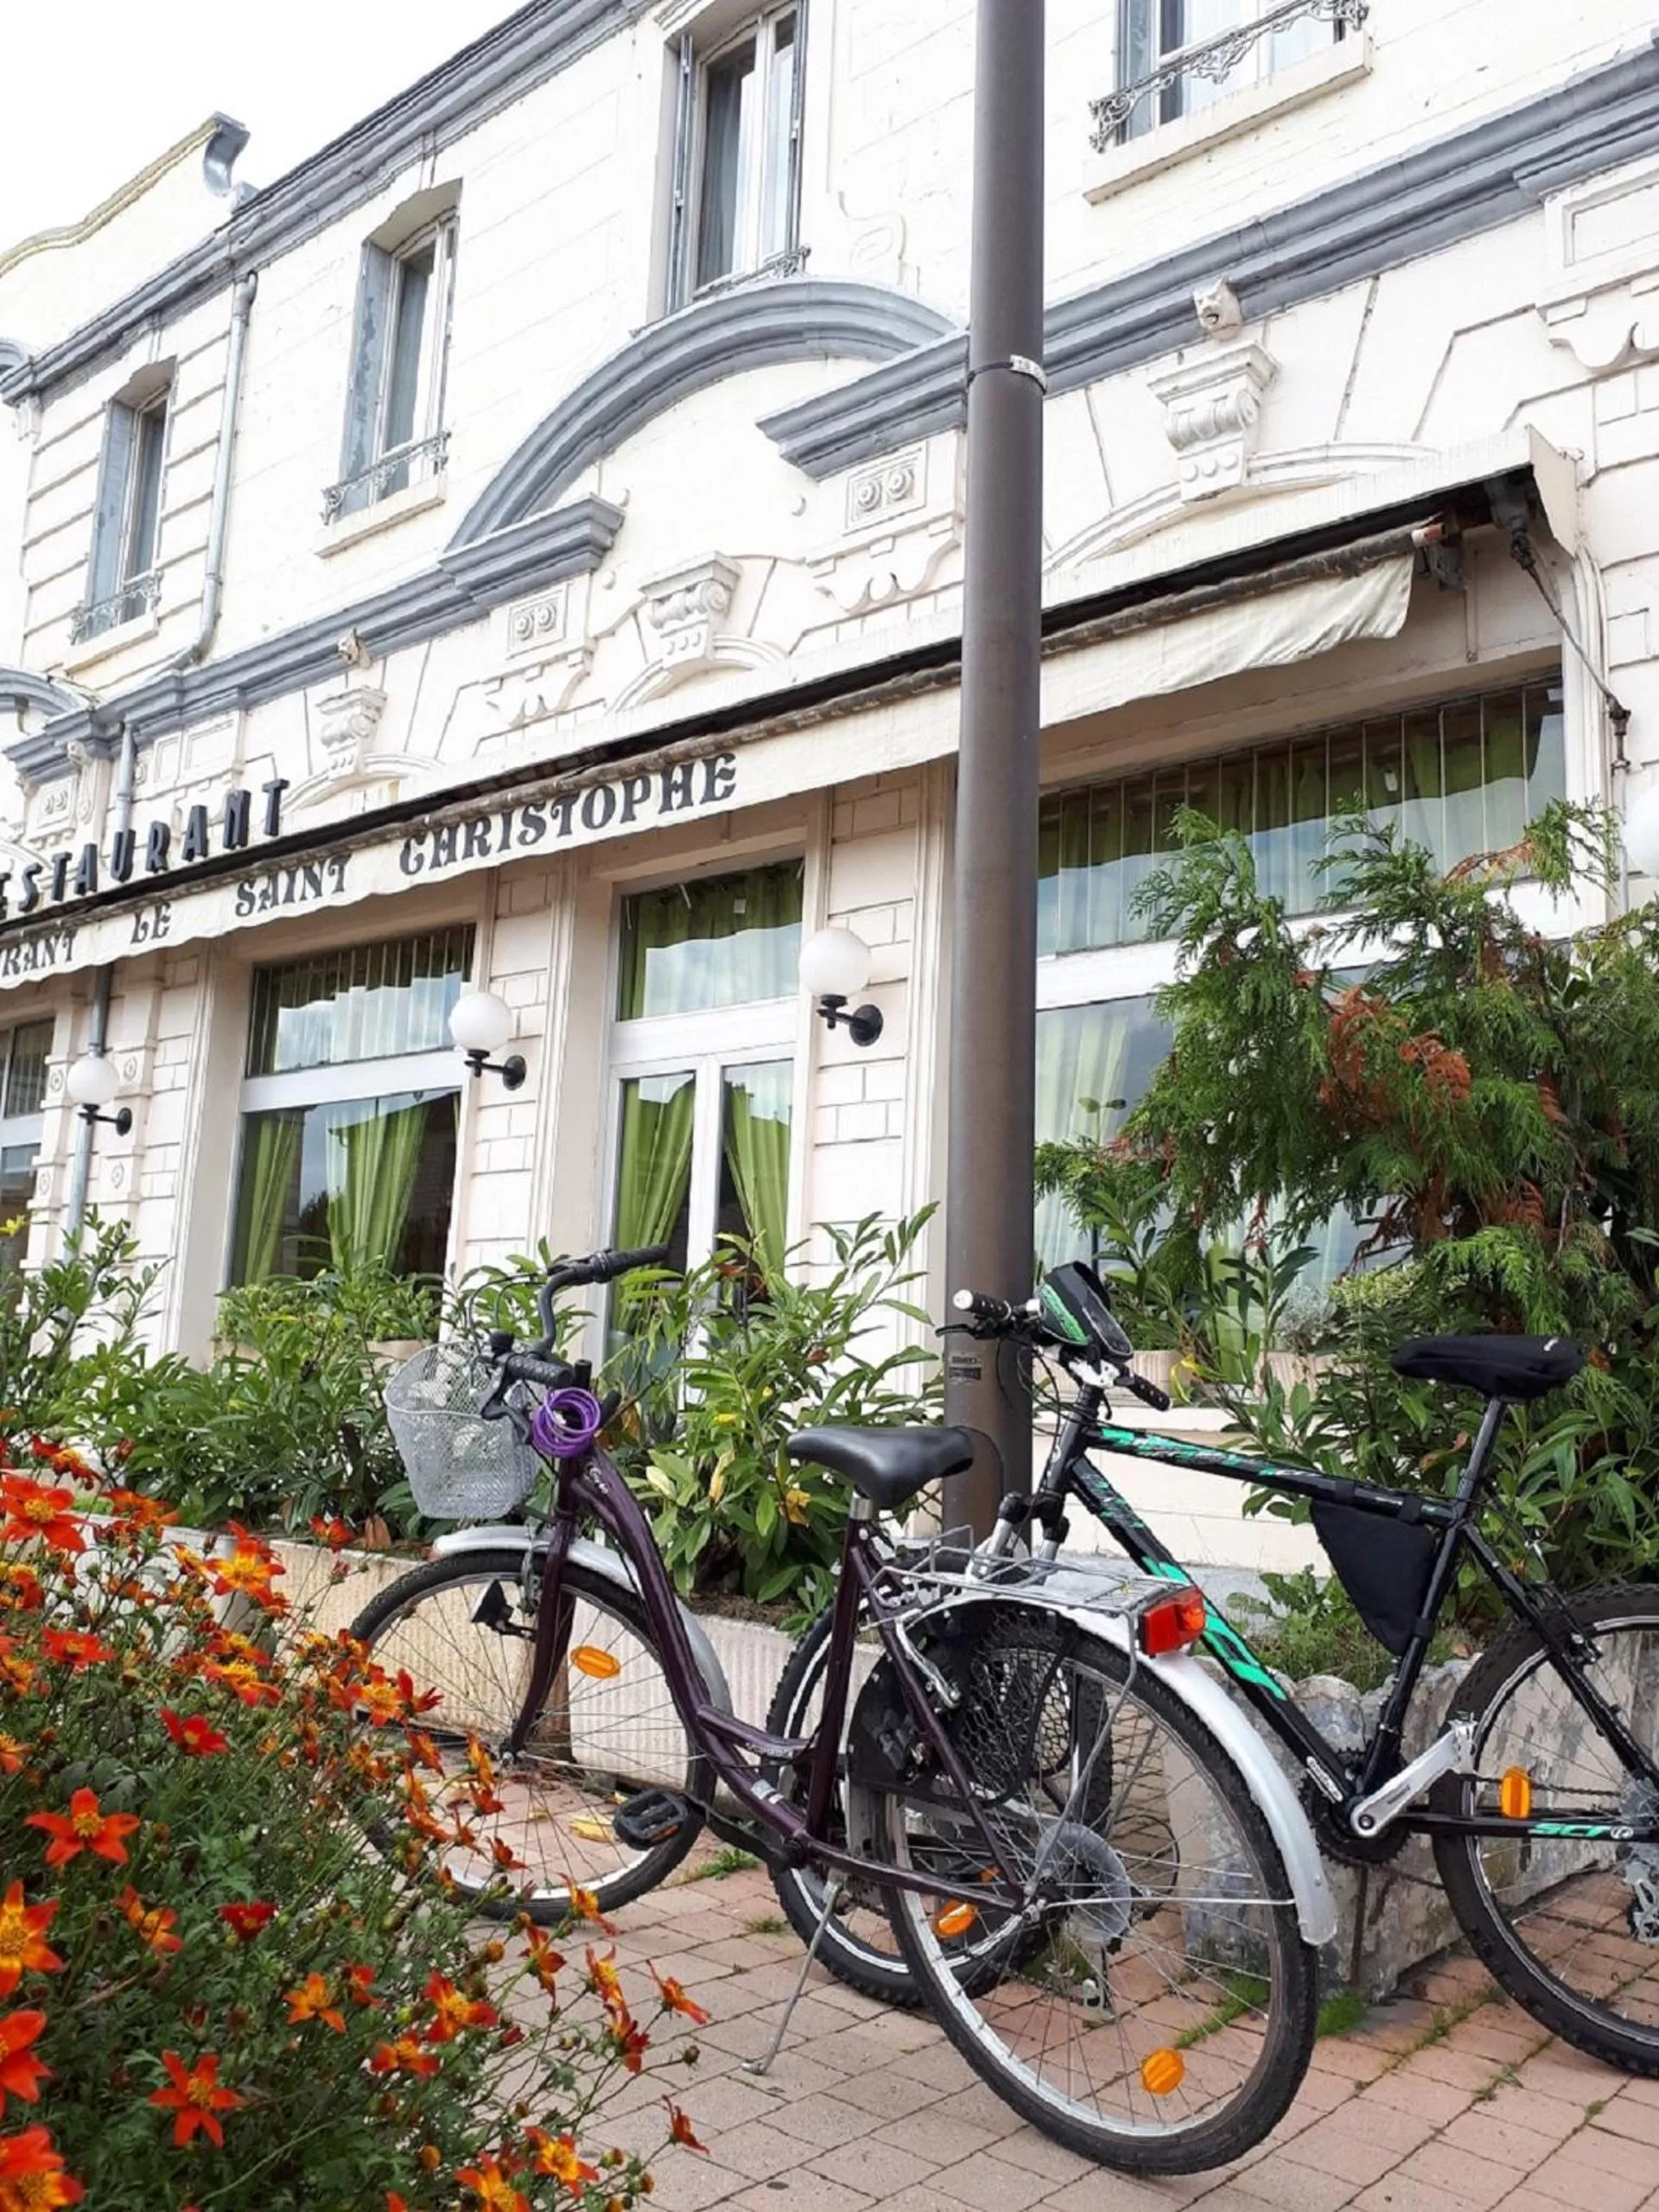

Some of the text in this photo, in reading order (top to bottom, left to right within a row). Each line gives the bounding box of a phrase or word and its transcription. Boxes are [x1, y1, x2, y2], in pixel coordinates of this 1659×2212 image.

[130, 902, 171, 944] LE
[235, 854, 353, 918] SAINT
[399, 752, 737, 876] CHRISTOPHE
